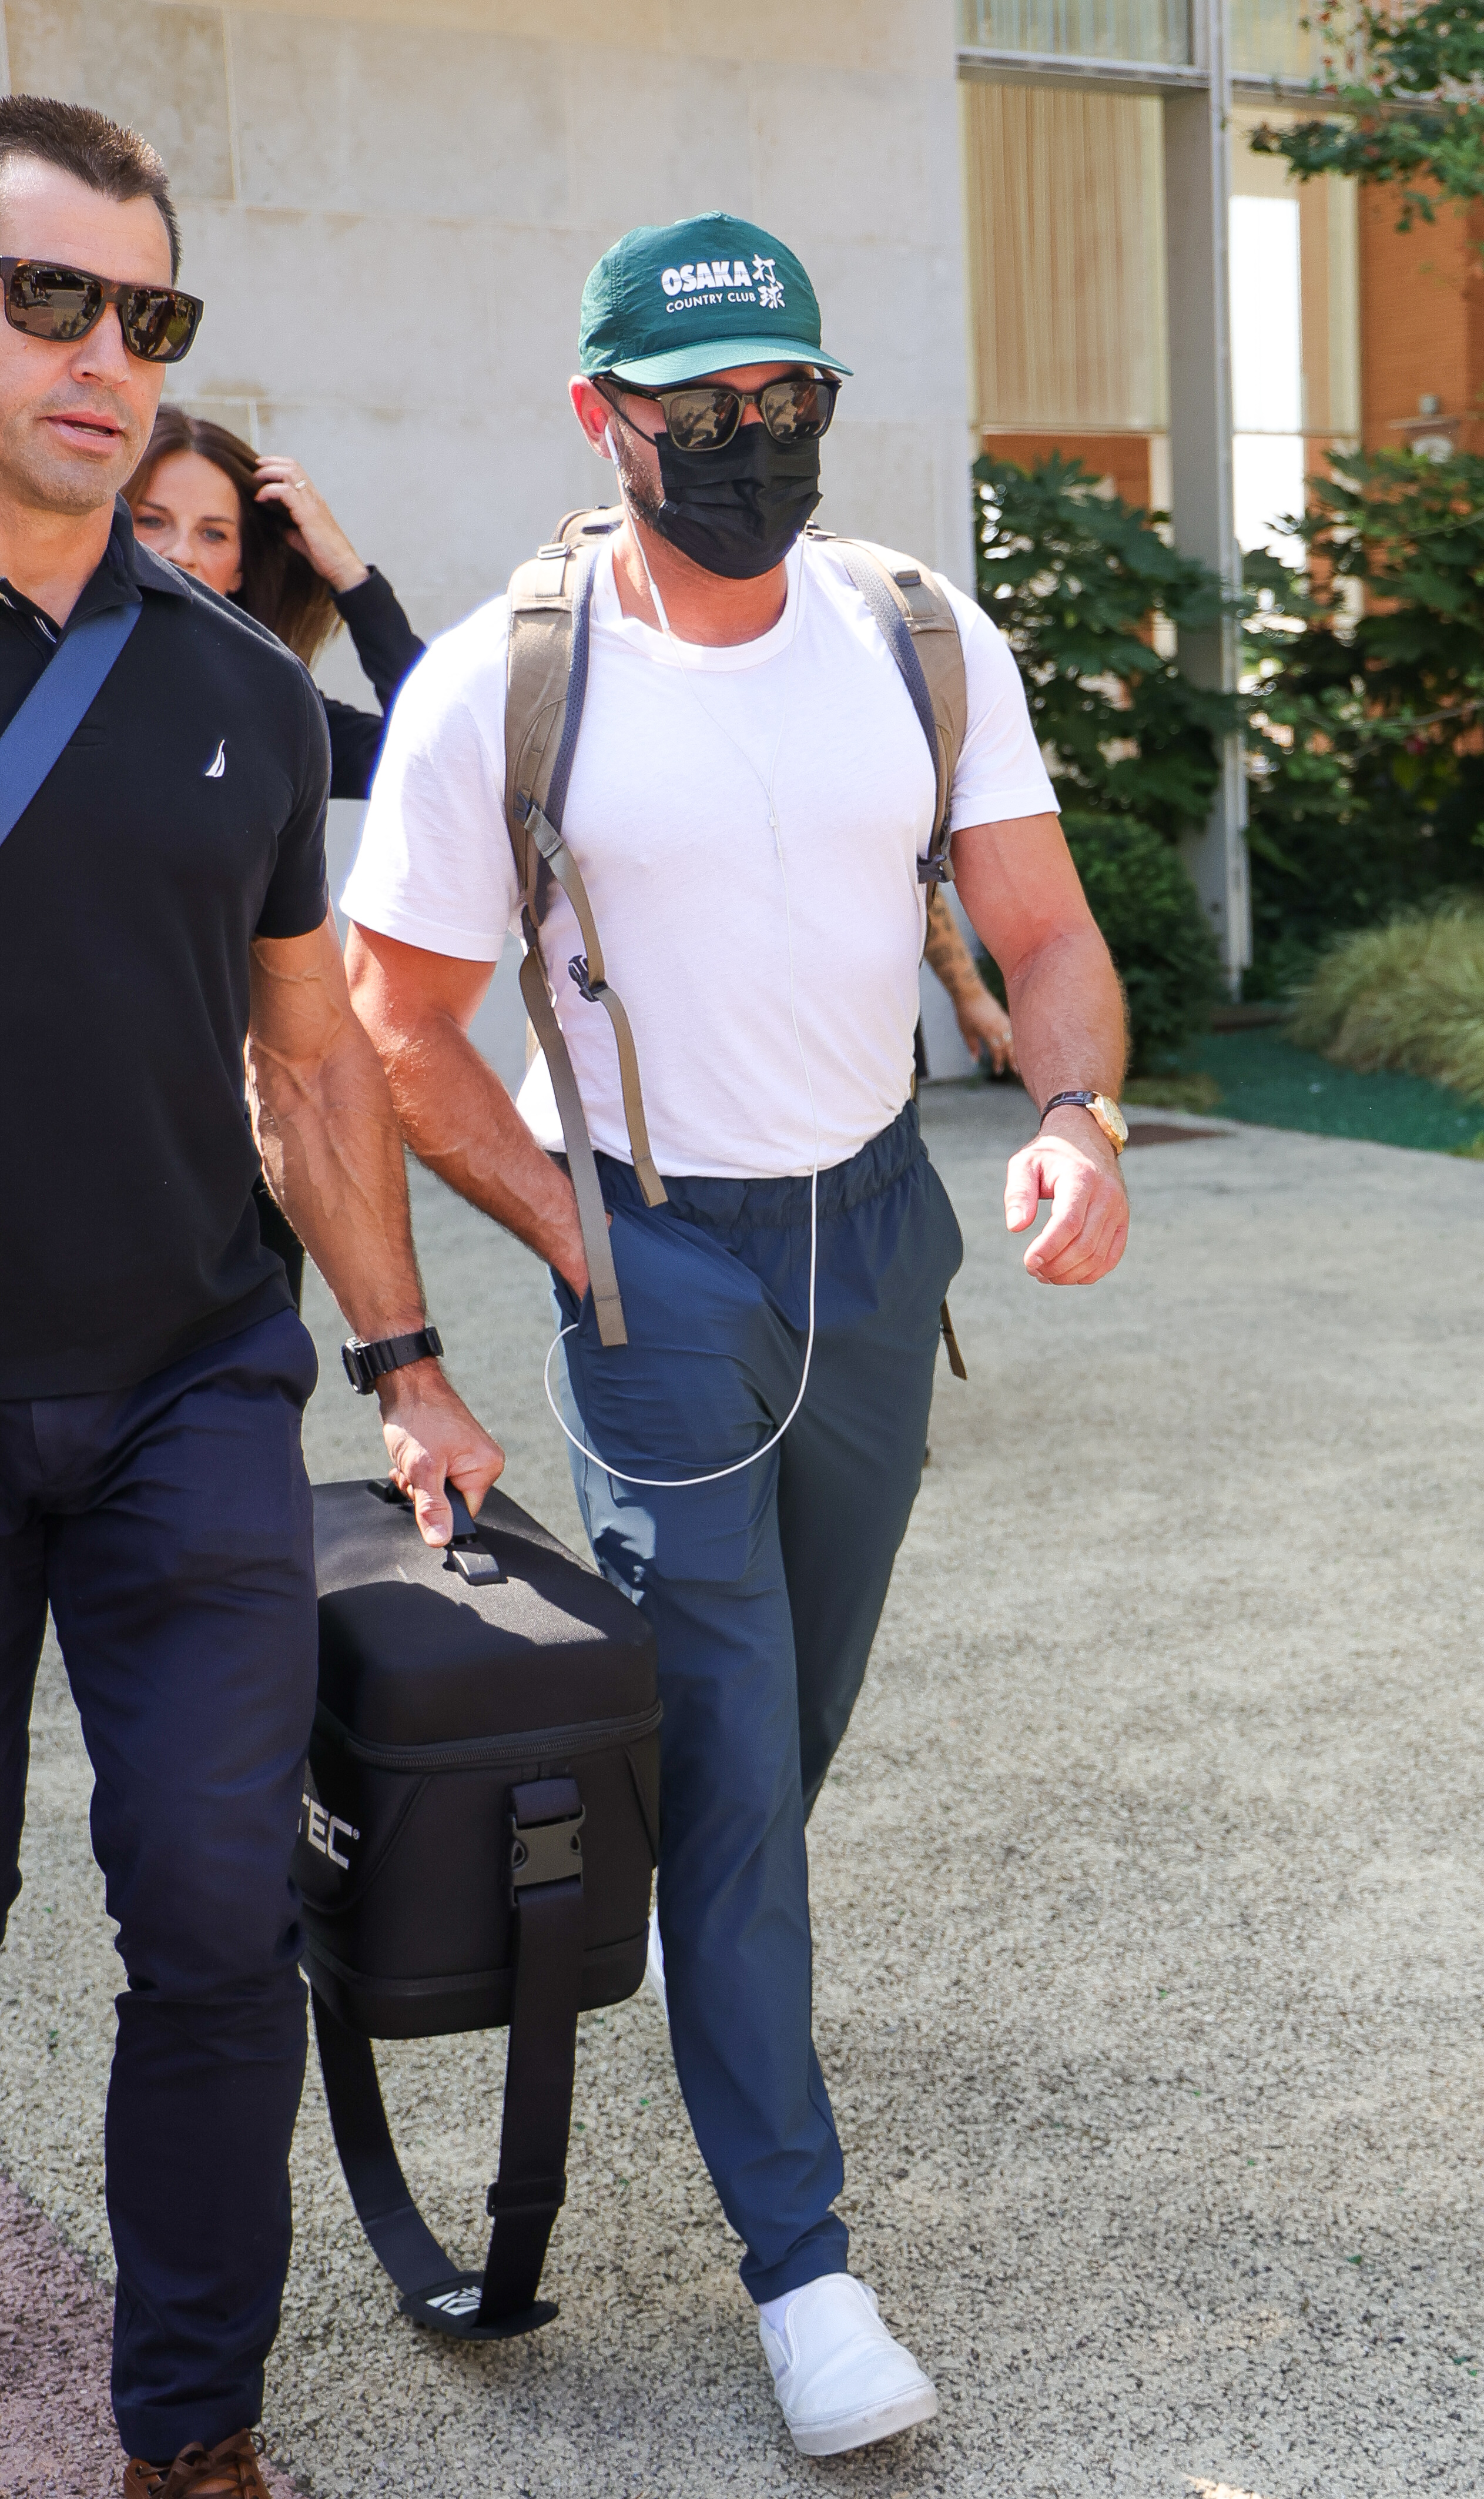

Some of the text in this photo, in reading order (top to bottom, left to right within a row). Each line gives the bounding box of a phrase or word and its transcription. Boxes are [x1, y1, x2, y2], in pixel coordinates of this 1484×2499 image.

[661, 260, 753, 296] OSAKA
[666, 292, 756, 313] COUNTRY CLUB
